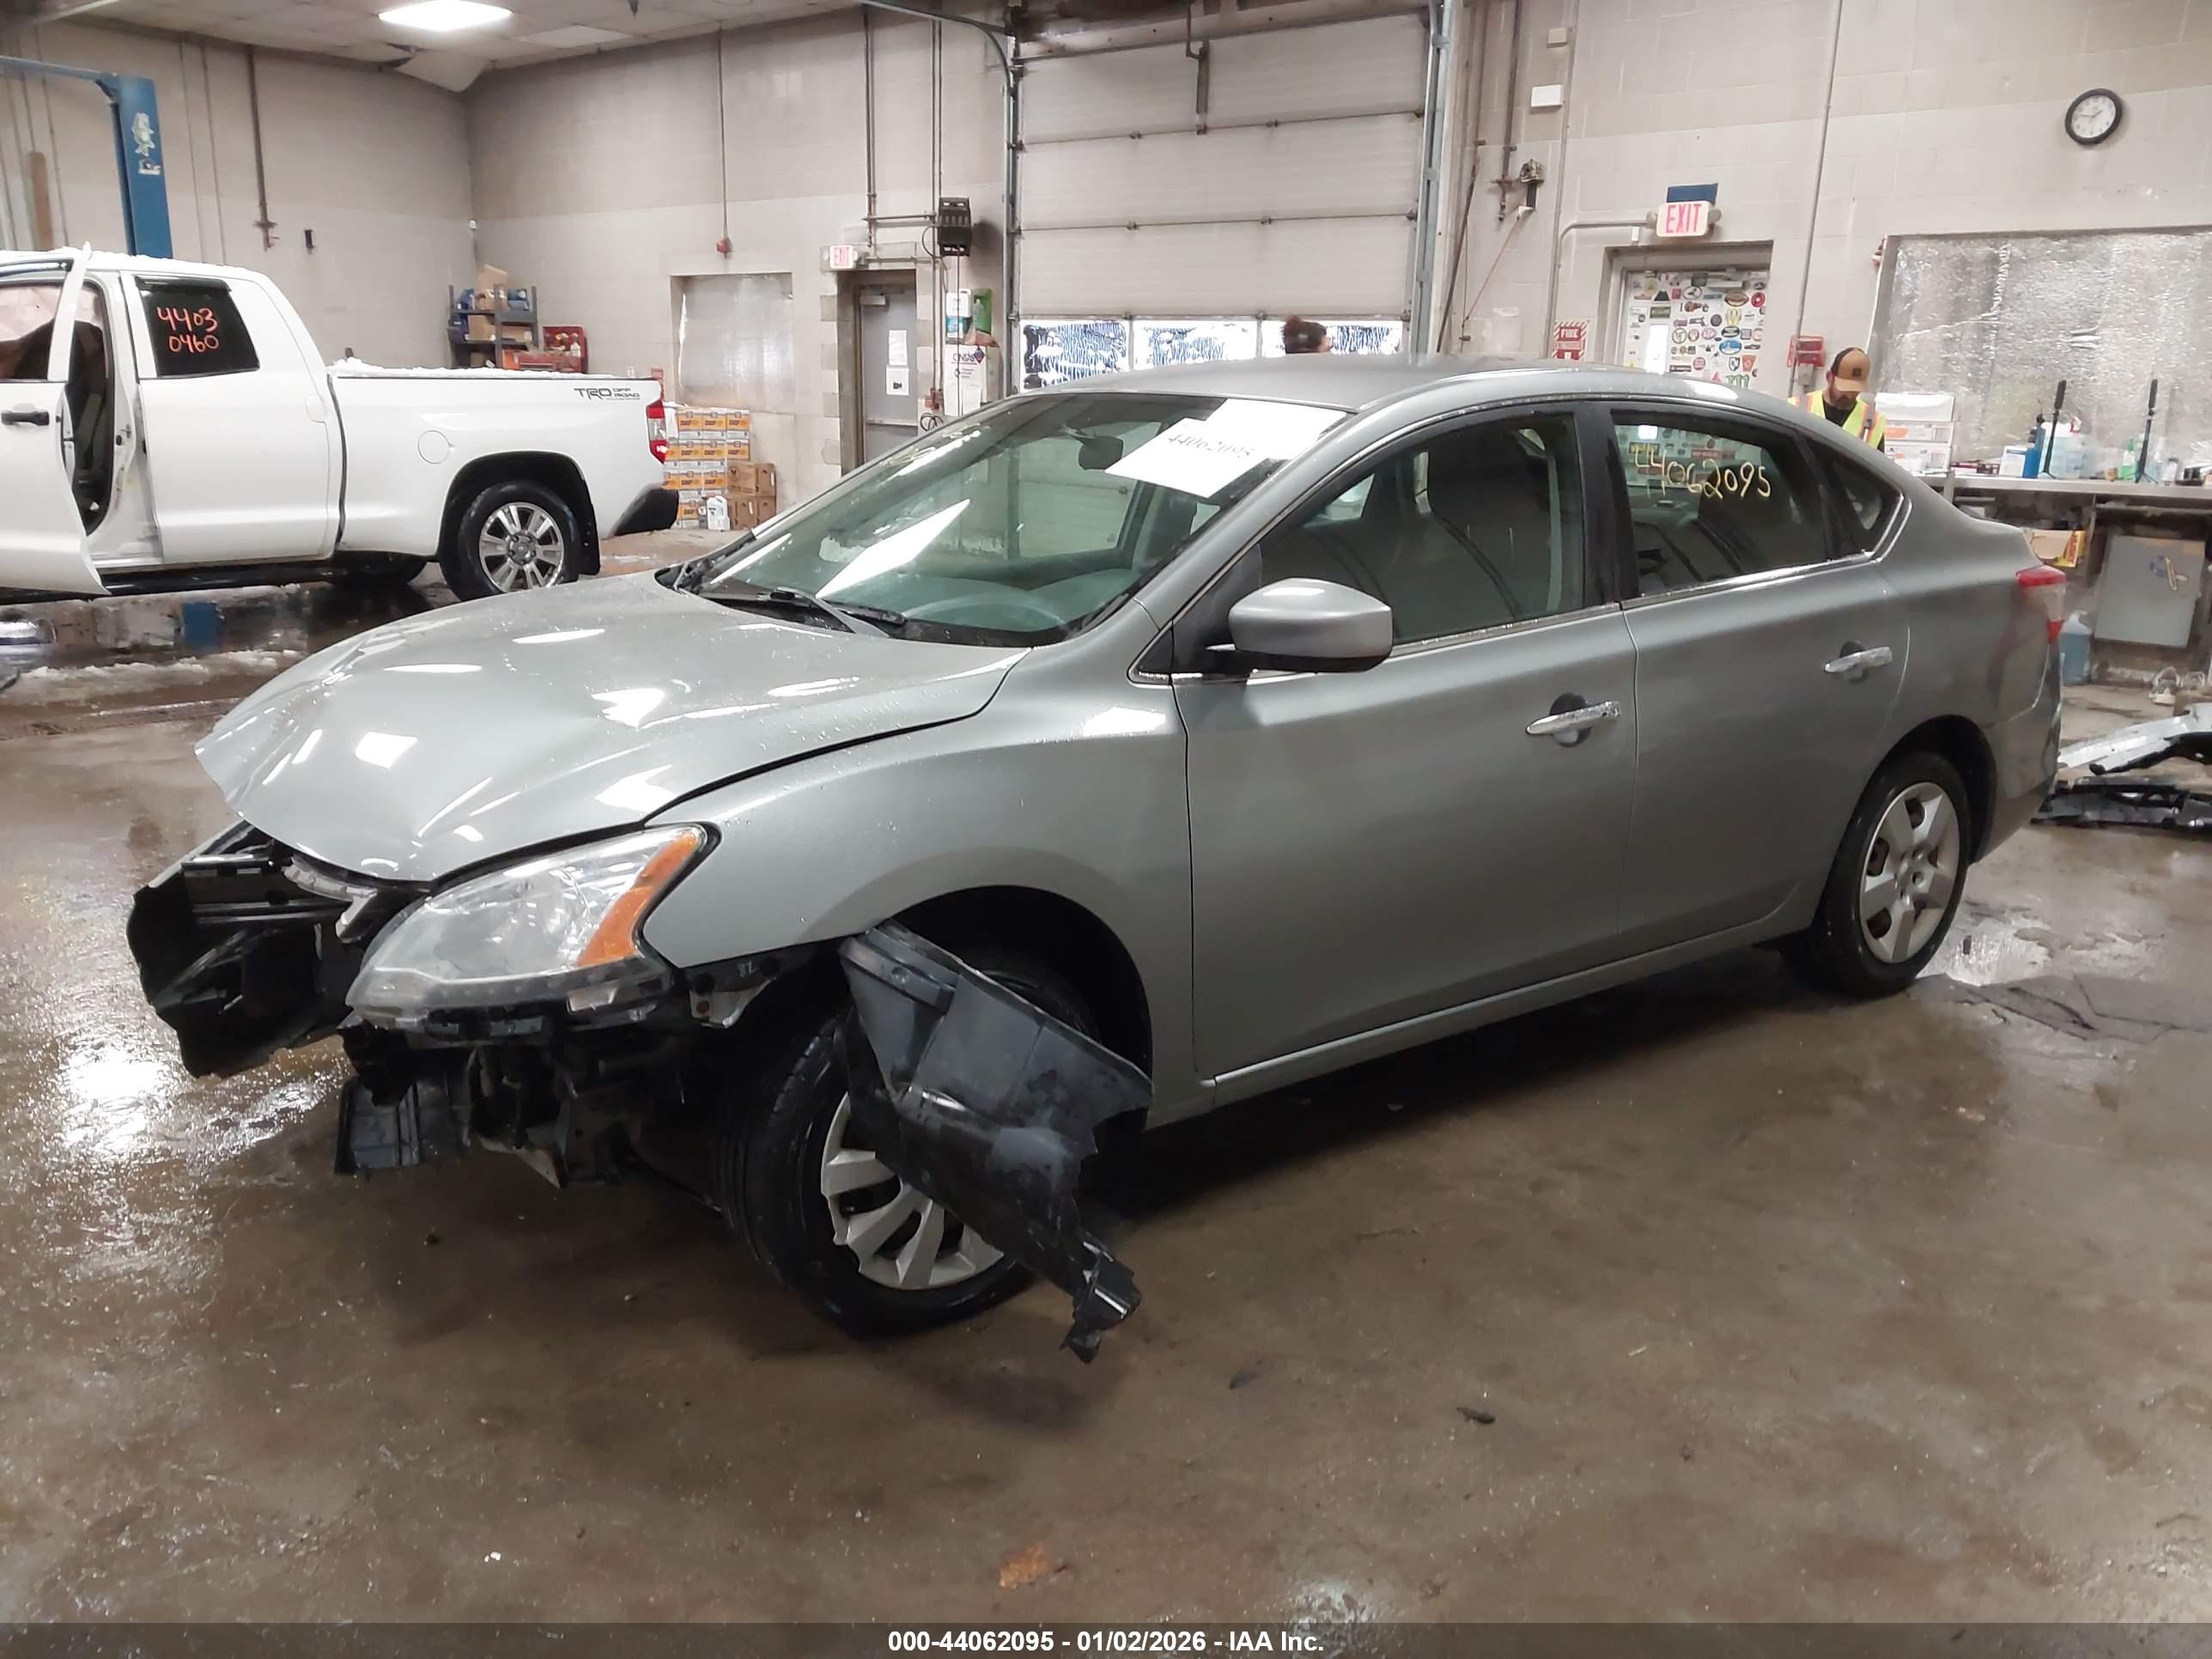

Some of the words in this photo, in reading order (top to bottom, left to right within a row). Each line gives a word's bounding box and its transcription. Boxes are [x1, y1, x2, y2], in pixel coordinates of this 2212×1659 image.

[1666, 203, 1702, 233] EXIT
[156, 307, 217, 331] 4403
[169, 334, 219, 353] 0460
[1635, 445, 1771, 500] 44062095
